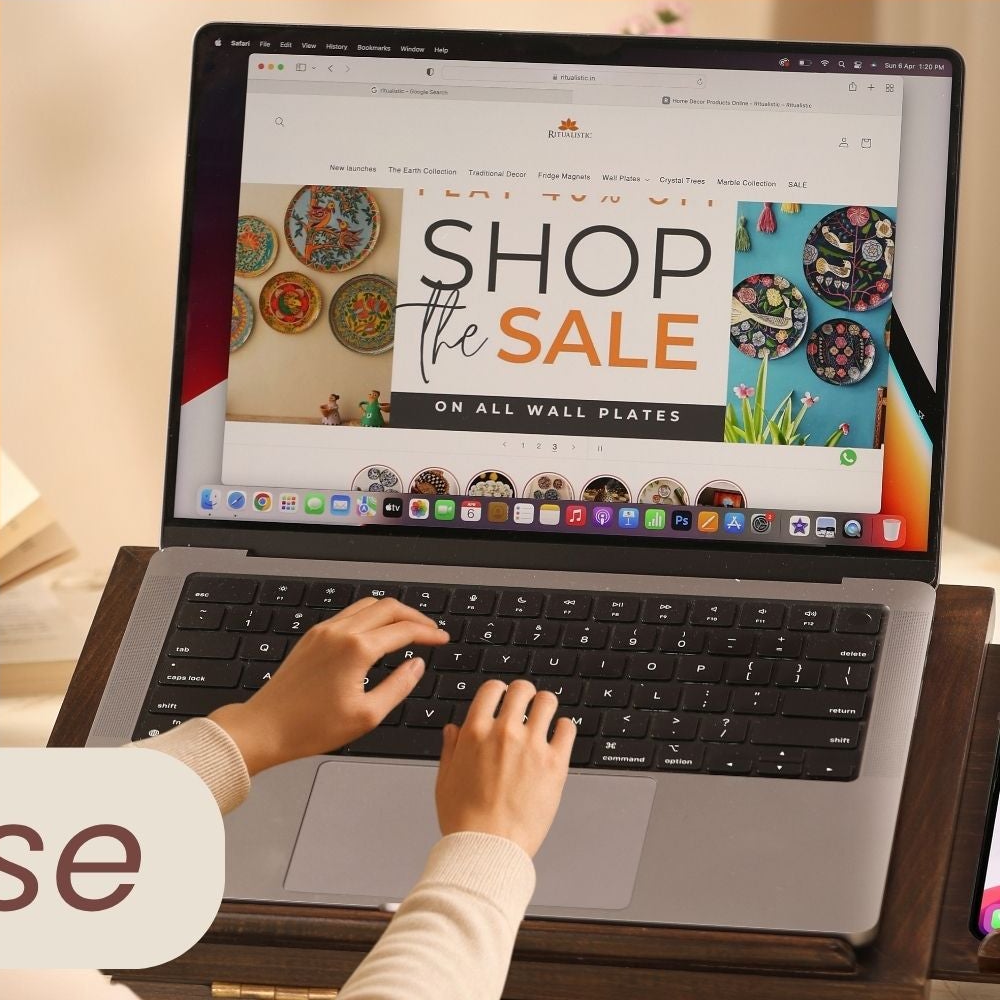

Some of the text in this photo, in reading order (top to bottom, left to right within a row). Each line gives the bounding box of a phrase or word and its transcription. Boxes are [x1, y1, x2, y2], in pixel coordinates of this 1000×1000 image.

[326, 43, 348, 51] History
[358, 44, 391, 52] Bookmarks
[409, 88, 429, 96] Google
[329, 164, 377, 173] New launches
[389, 166, 401, 174] The
[423, 167, 457, 176] Collection
[468, 169, 527, 178] Traditional Decor
[538, 172, 591, 182] Fridge Magnets
[602, 174, 641, 183] Wall Plates
[659, 176, 706, 185] Crystal Trees
[717, 178, 777, 188] Marble Collection
[788, 181, 808, 189] SALE
[420, 219, 712, 299] SHOP
[395, 280, 699, 384] the SALE
[435, 400, 681, 422] ON ALL WALL PLATES
[552, 443, 558, 451] 3
[391, 504, 401, 512] tv
[467, 508, 475, 519] 6
[675, 515, 689, 526] Ps
[245, 619, 251, 627] 1
[292, 621, 300, 630] 2
[484, 631, 492, 639] 6
[533, 633, 541, 641] 7
[580, 635, 589, 644] 8
[629, 638, 637, 646] 9
[260, 643, 270, 652] Q
[404, 651, 413, 659] R
[454, 653, 462, 661] T
[502, 655, 511, 663] Y
[550, 658, 559, 666] U
[647, 662, 657, 671] O
[748, 661, 754, 671] {
[697, 664, 706, 672] P
[797, 664, 803, 673] }
[167, 674, 187, 682] caps
[262, 672, 272, 680] A
[746, 672, 752, 681] [
[795, 674, 800, 683] ]
[457, 682, 467, 690] G
[554, 686, 563, 695] J
[603, 689, 613, 697] K
[425, 709, 435, 718] V
[571, 717, 583, 725] M
[722, 718, 730, 727] ?
[602, 755, 646, 764] command
[664, 758, 693, 766] option
